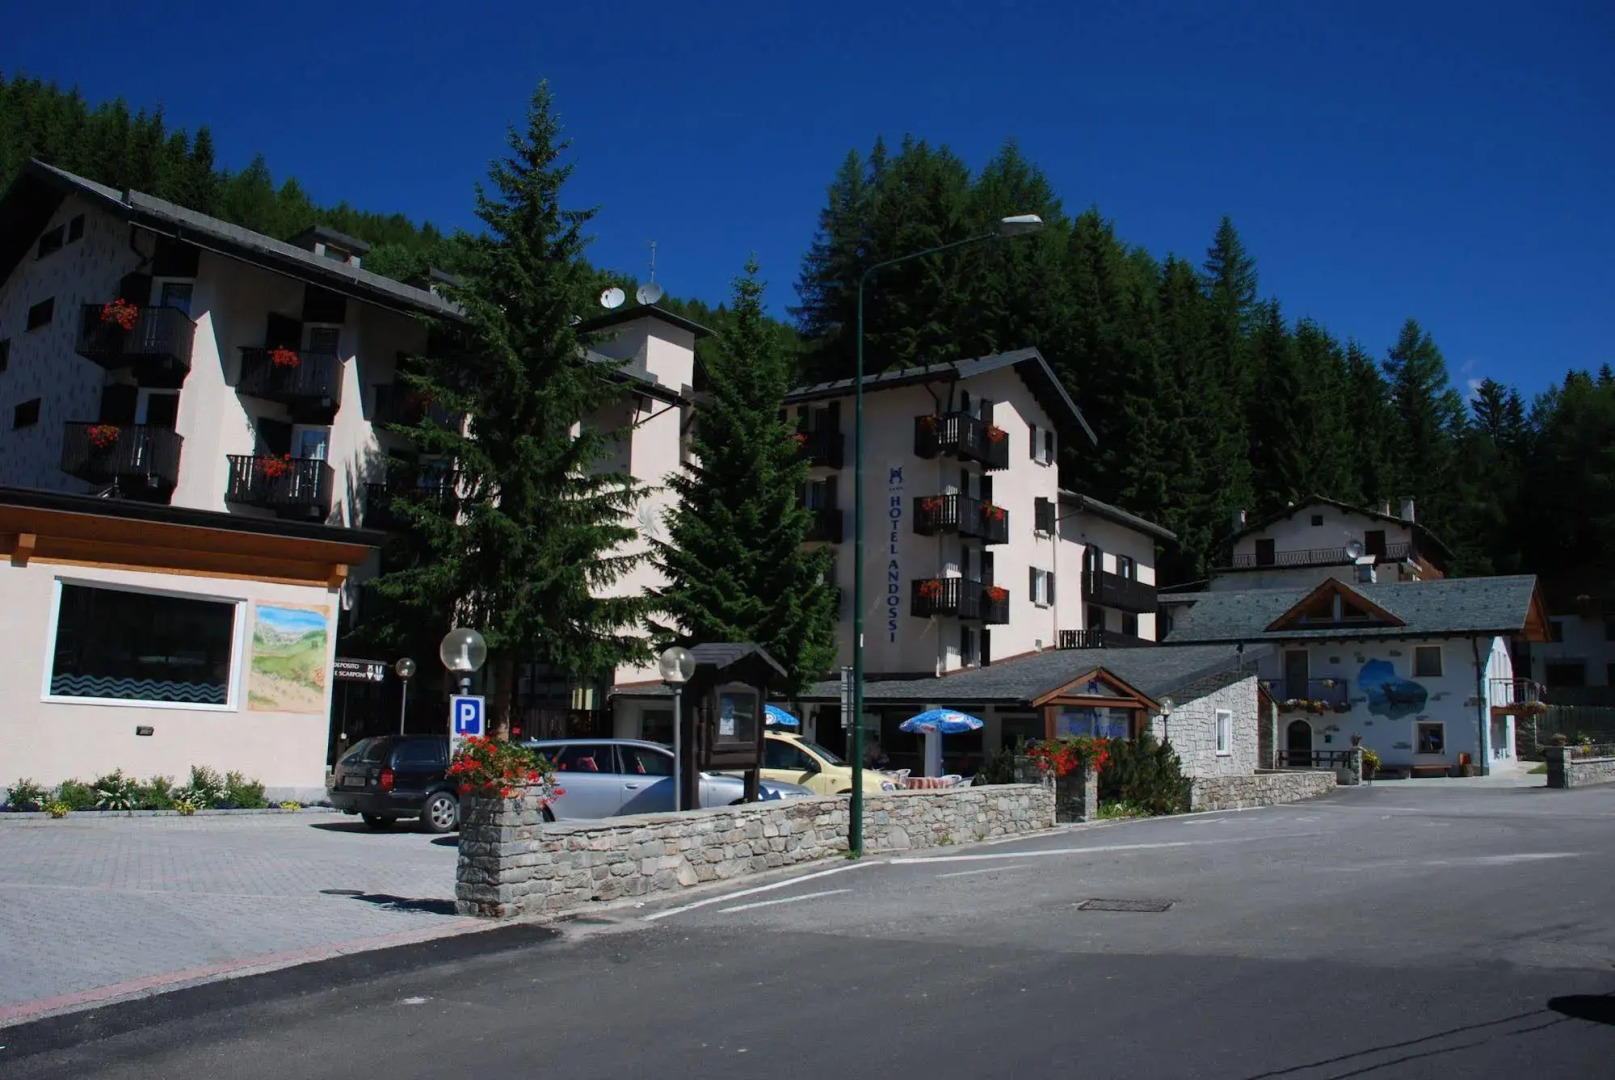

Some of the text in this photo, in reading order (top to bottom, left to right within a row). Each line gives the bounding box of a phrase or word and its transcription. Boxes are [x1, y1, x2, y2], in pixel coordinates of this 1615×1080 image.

[887, 496, 901, 643] HOTEL ANDOSSI
[461, 704, 475, 729] P
